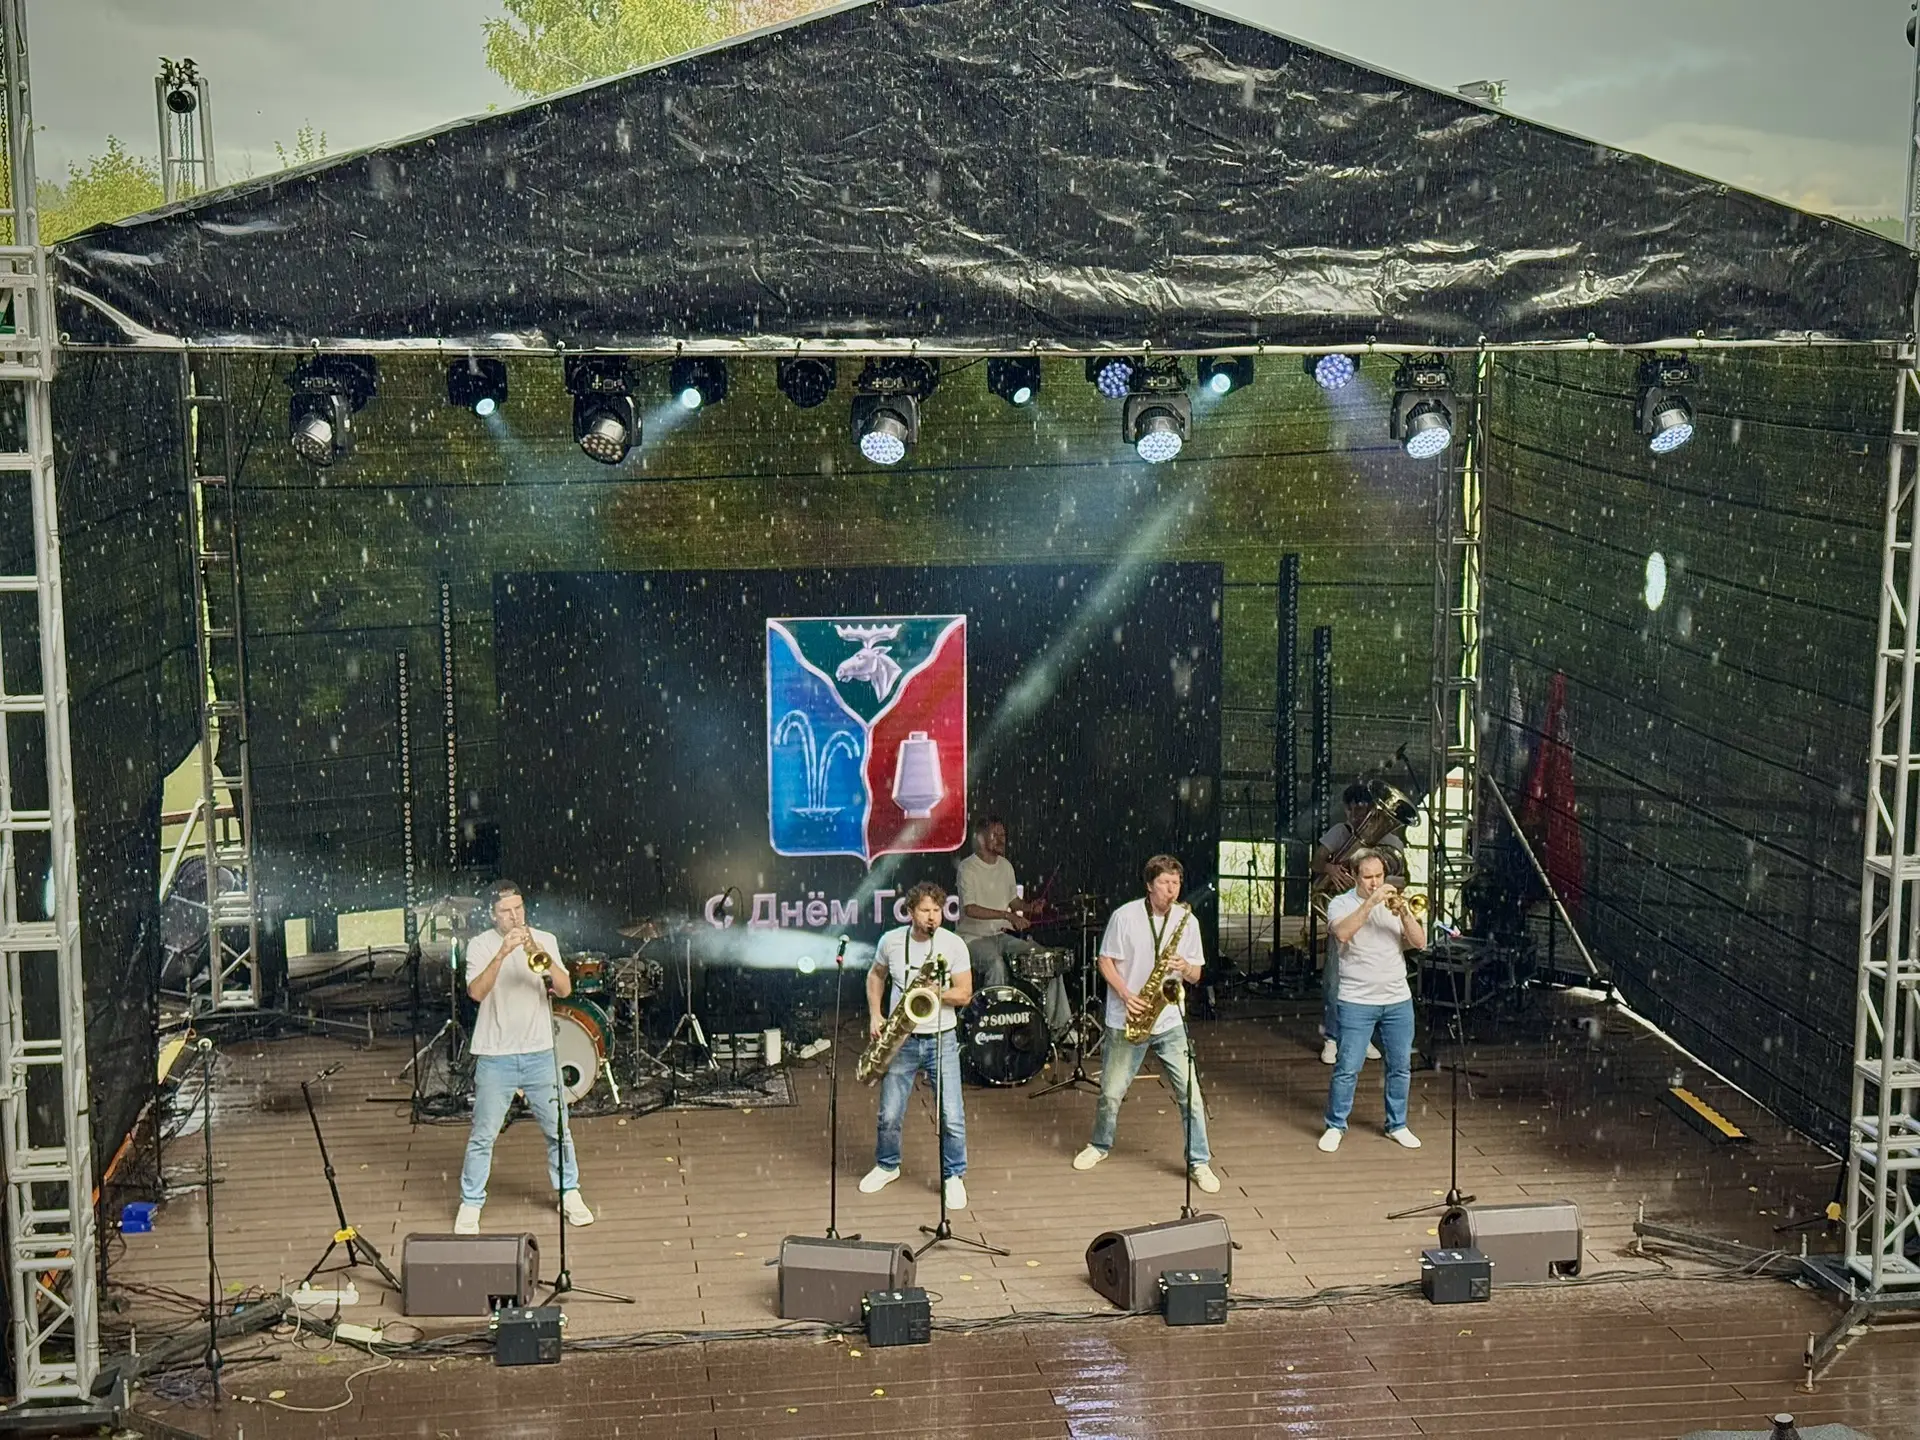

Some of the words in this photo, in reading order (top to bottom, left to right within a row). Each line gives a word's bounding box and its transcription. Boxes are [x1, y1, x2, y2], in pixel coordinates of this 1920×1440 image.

[704, 893, 734, 929] С
[747, 891, 858, 930] Днём
[990, 1011, 1030, 1026] SONOR
